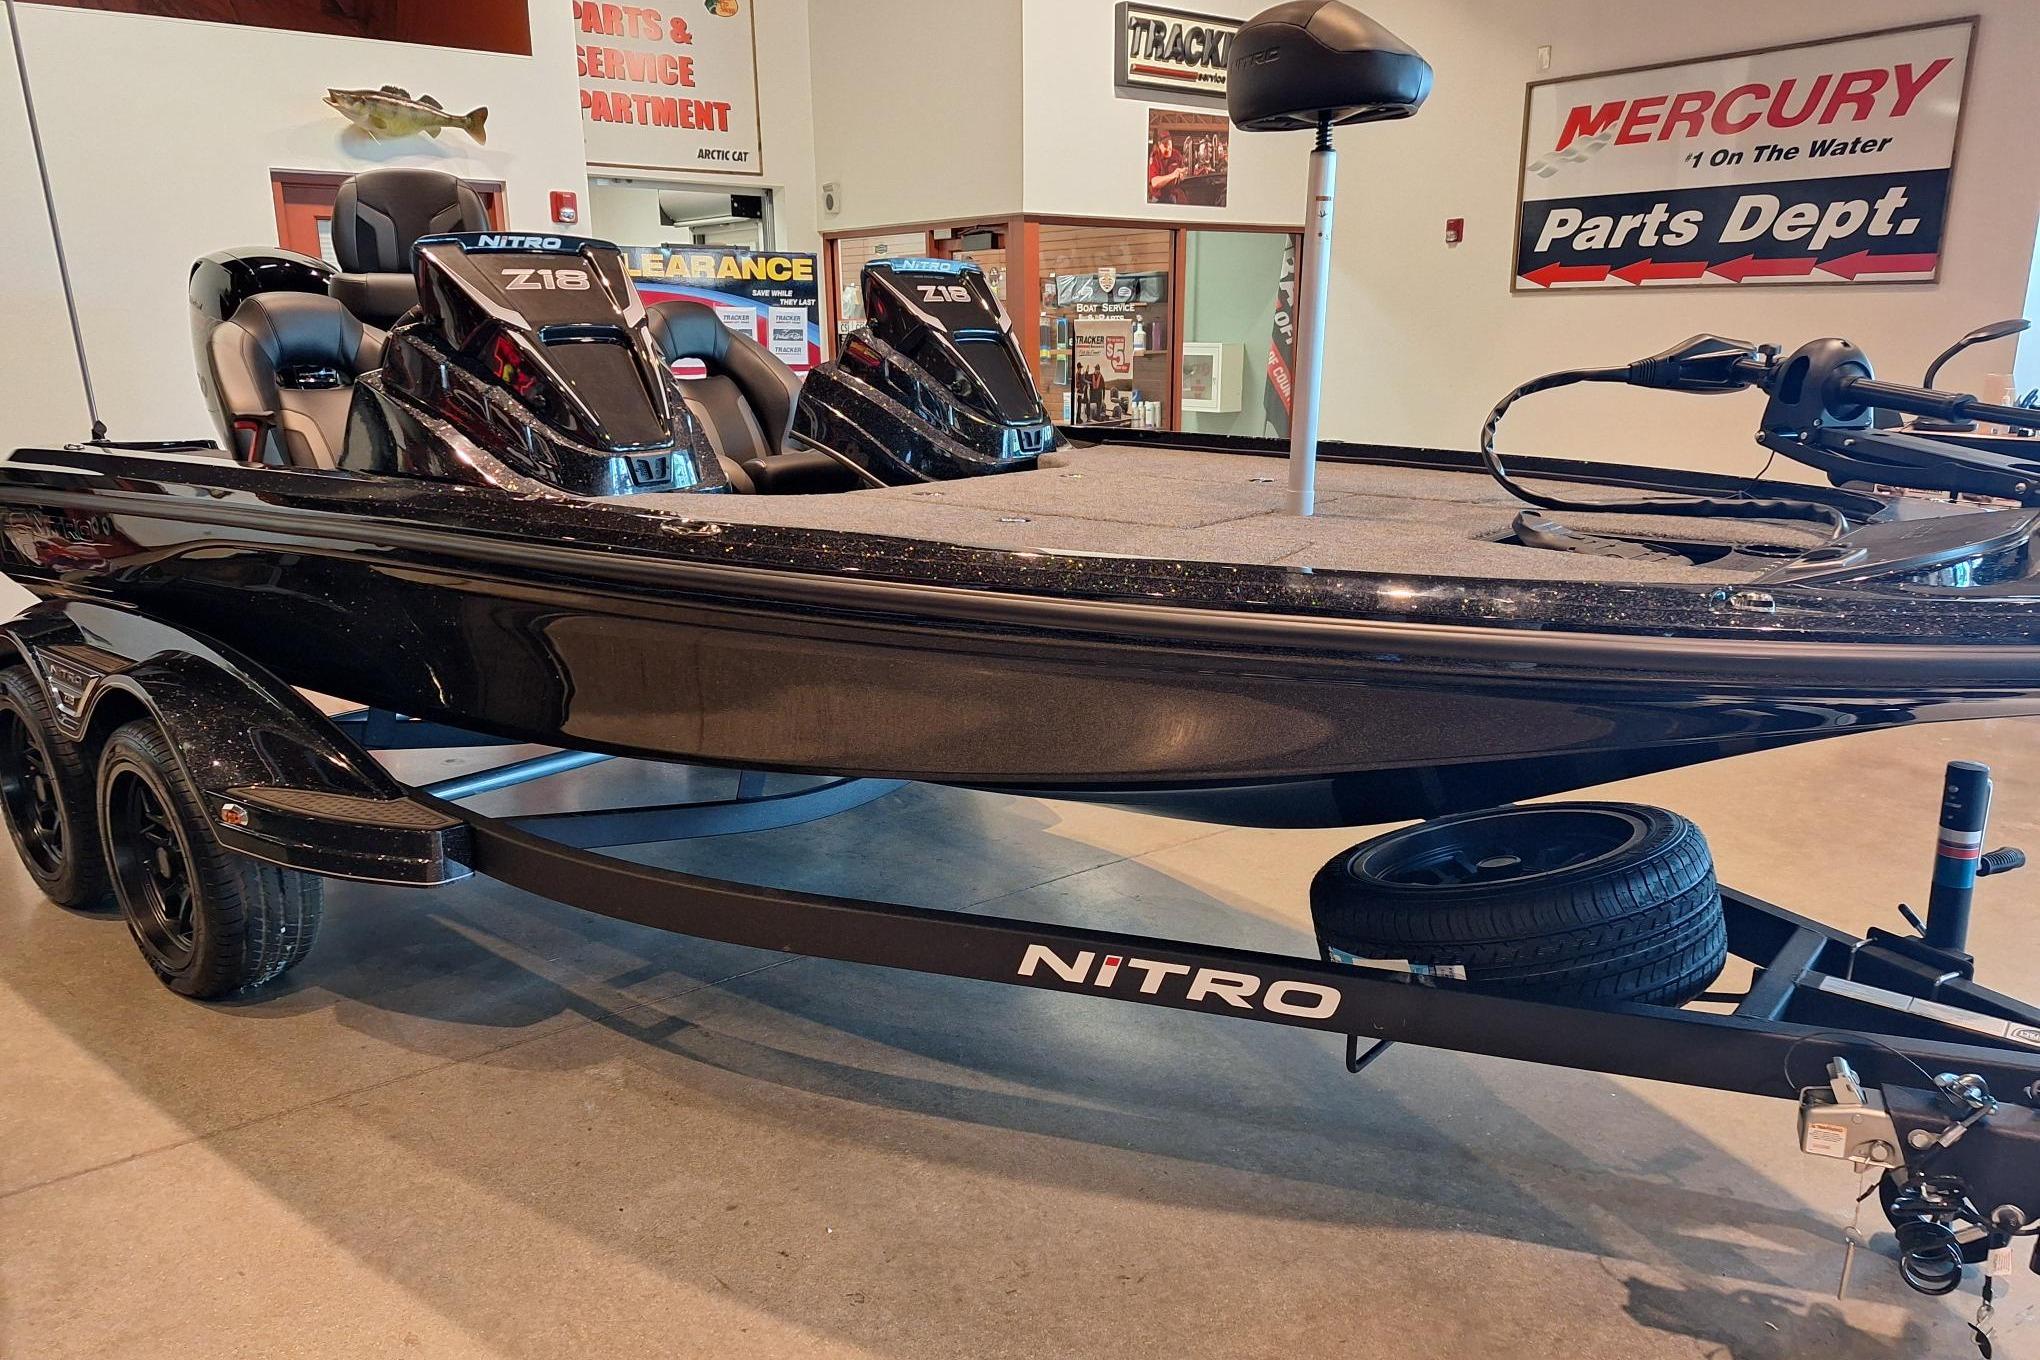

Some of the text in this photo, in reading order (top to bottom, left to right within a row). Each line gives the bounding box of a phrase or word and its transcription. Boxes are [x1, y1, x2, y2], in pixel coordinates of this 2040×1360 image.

[573, 0, 693, 45] PARTS &
[576, 44, 695, 87] SERVICE
[1555, 58, 1954, 151] MERCURY
[697, 148, 749, 162] ARCTIC CAT
[1684, 136, 1893, 168] #1 On The Water
[1533, 186, 1922, 253] Parts Dept.
[478, 234, 562, 250] NITRO
[902, 259, 951, 271] NITRO
[501, 268, 591, 291] Z18
[751, 289, 793, 297] SAVE WHILE
[916, 285, 972, 303] Z18
[1076, 335, 1105, 344] TRACKER
[1017, 943, 1342, 1019] NITRO
